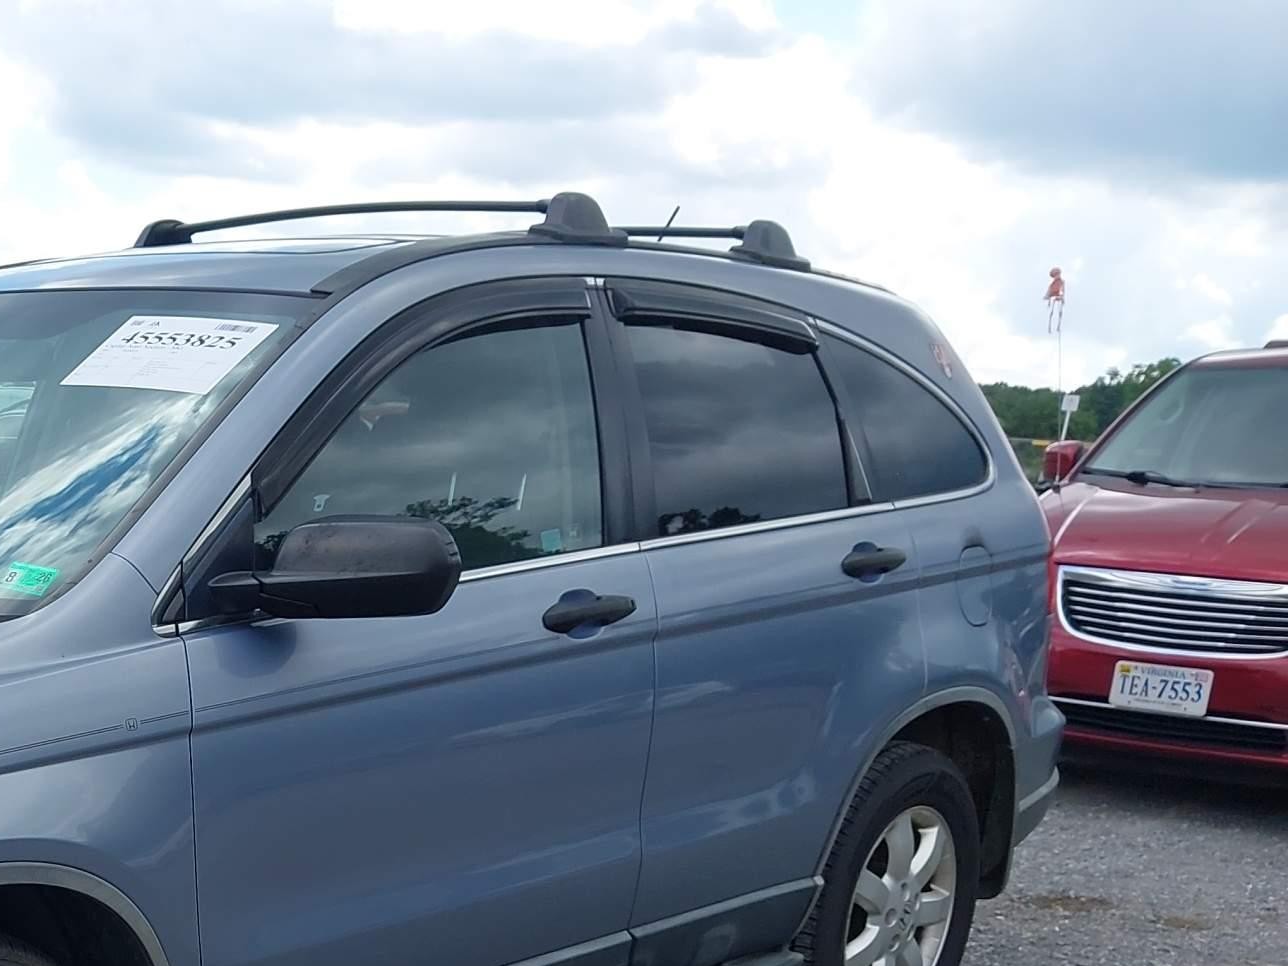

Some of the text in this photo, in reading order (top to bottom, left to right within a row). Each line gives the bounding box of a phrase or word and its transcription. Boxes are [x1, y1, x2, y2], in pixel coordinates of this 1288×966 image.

[121, 331, 243, 349] 45553825
[1140, 666, 1187, 680] VIRGINIA
[1119, 674, 1203, 703] TEA-7553
